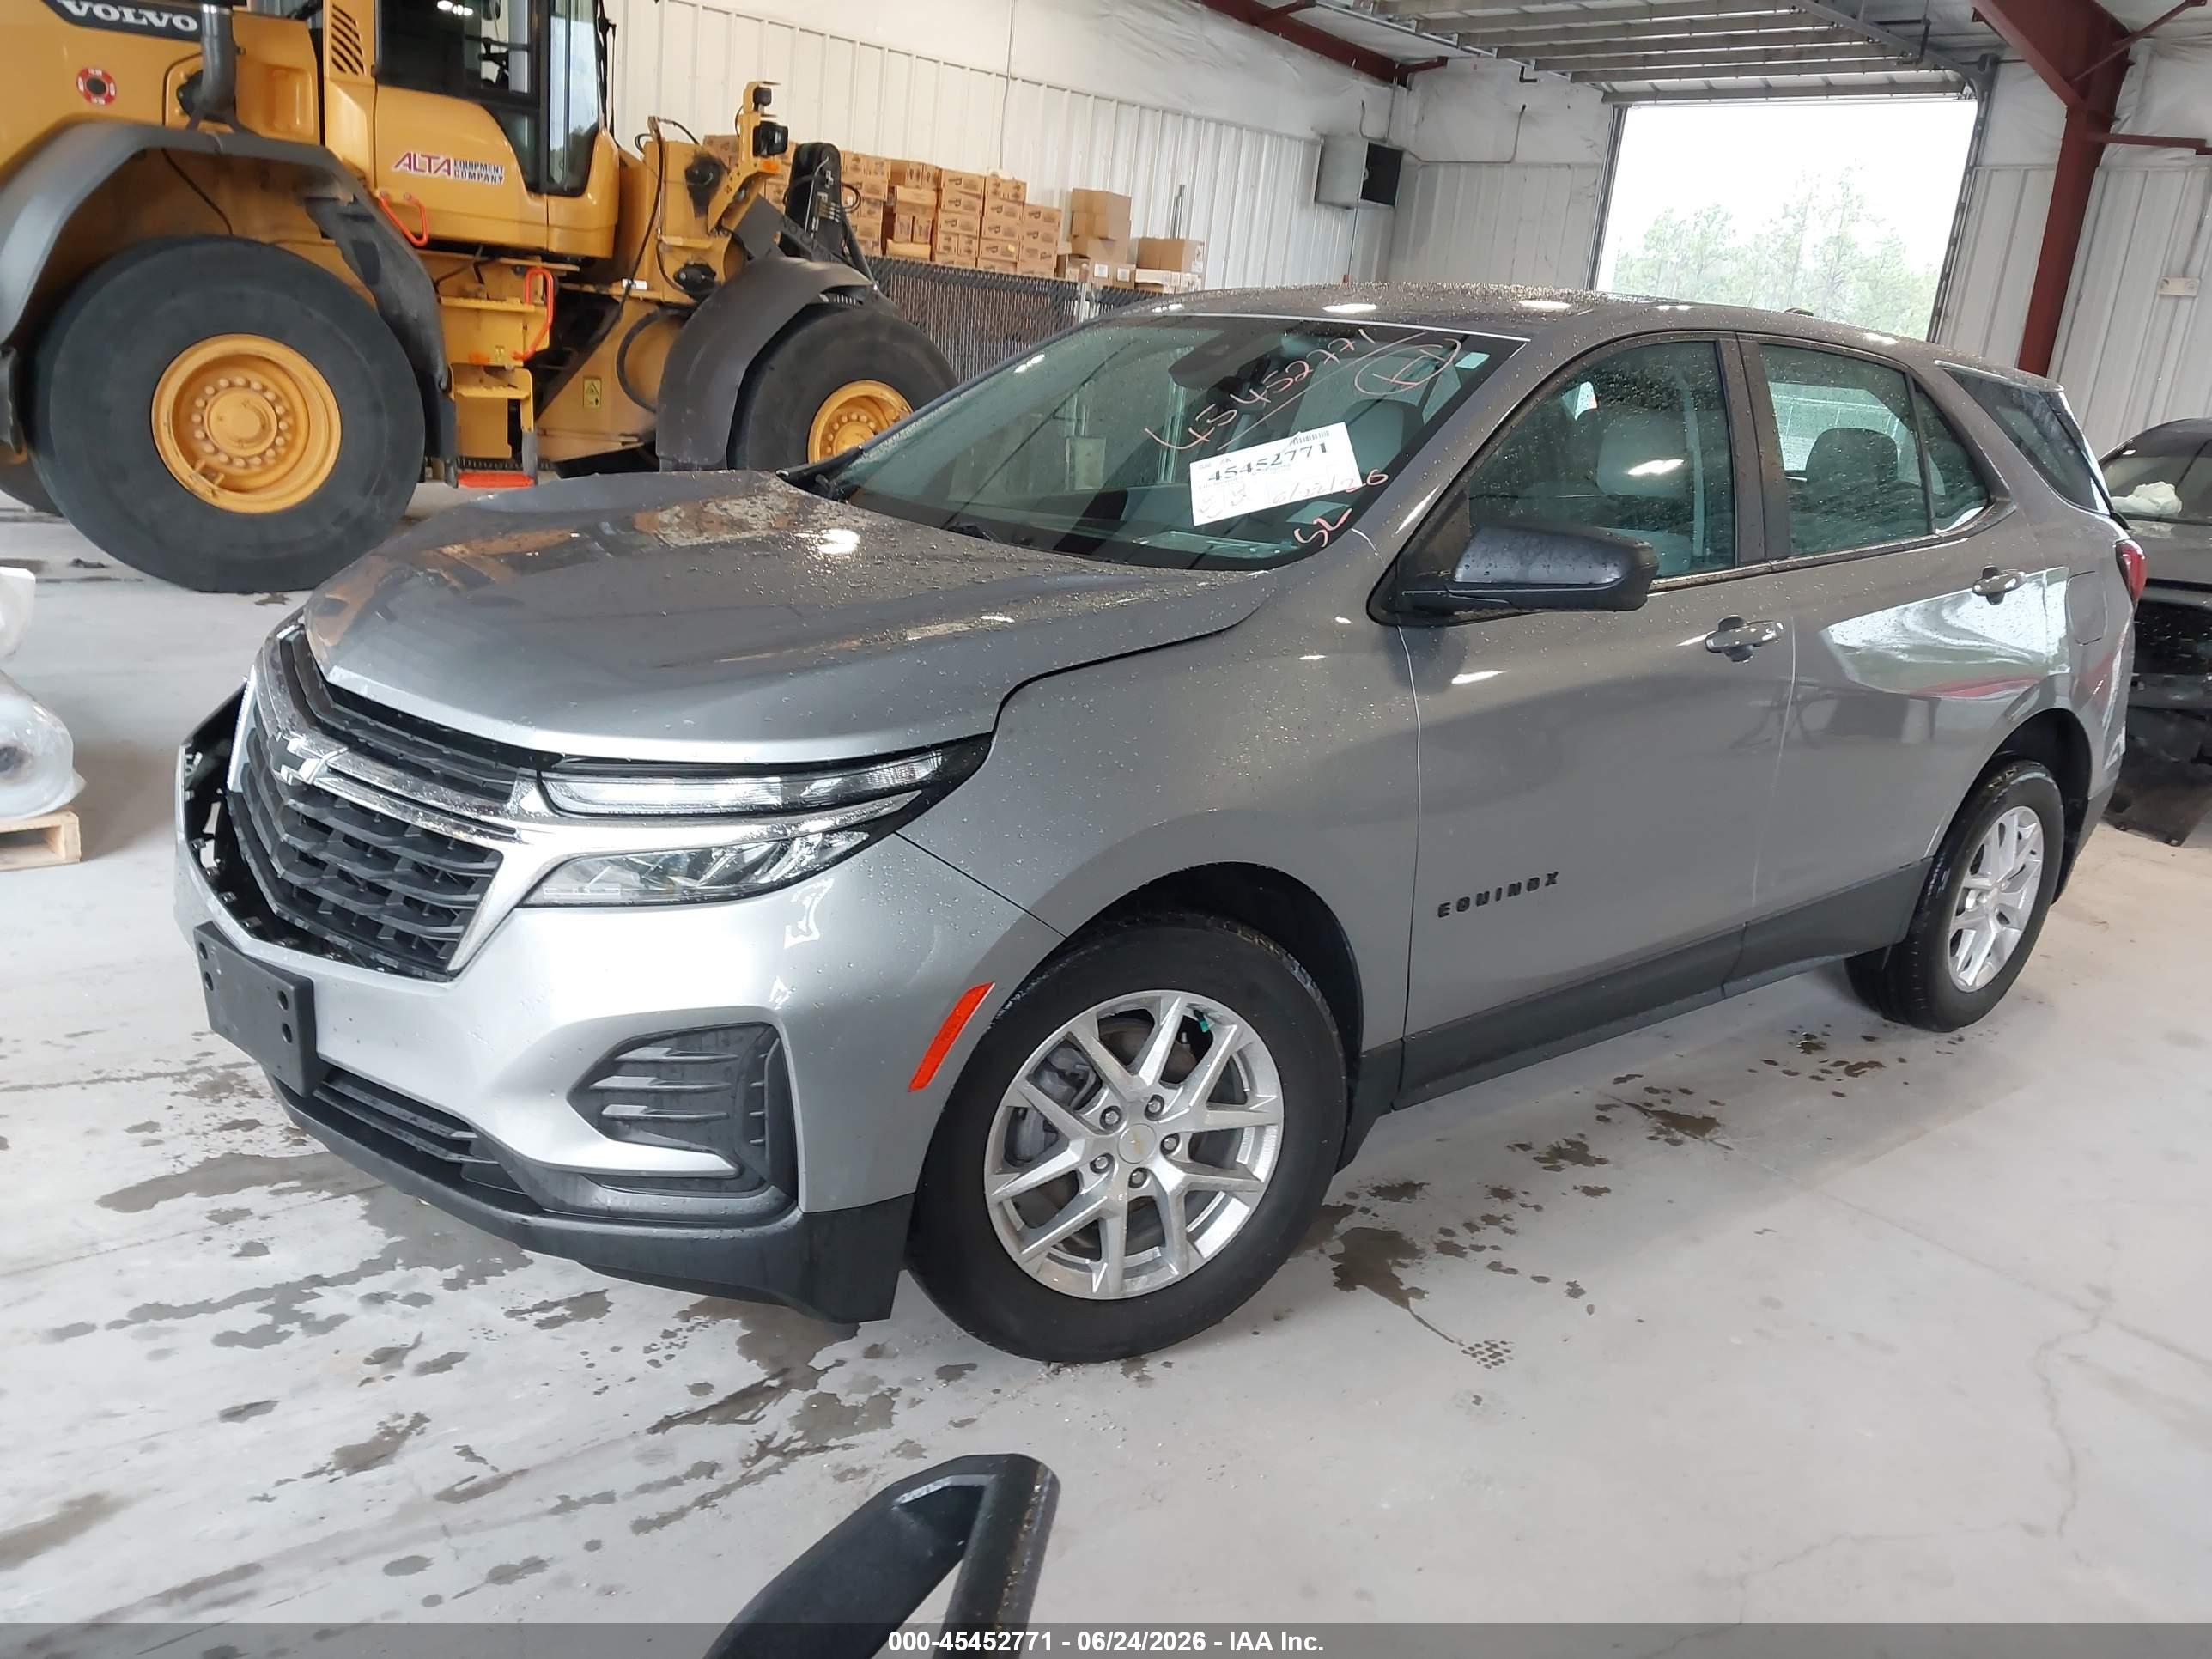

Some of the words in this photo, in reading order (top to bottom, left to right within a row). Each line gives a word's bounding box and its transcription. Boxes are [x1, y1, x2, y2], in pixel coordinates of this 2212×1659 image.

[57, 0, 198, 32] VOLVO
[393, 151, 453, 177] ALTA
[453, 158, 504, 174] EQUIPMENT
[453, 171, 504, 185] COMPANY
[1207, 442, 1328, 481] 45452771
[1437, 871, 1559, 919] EQUINOX
